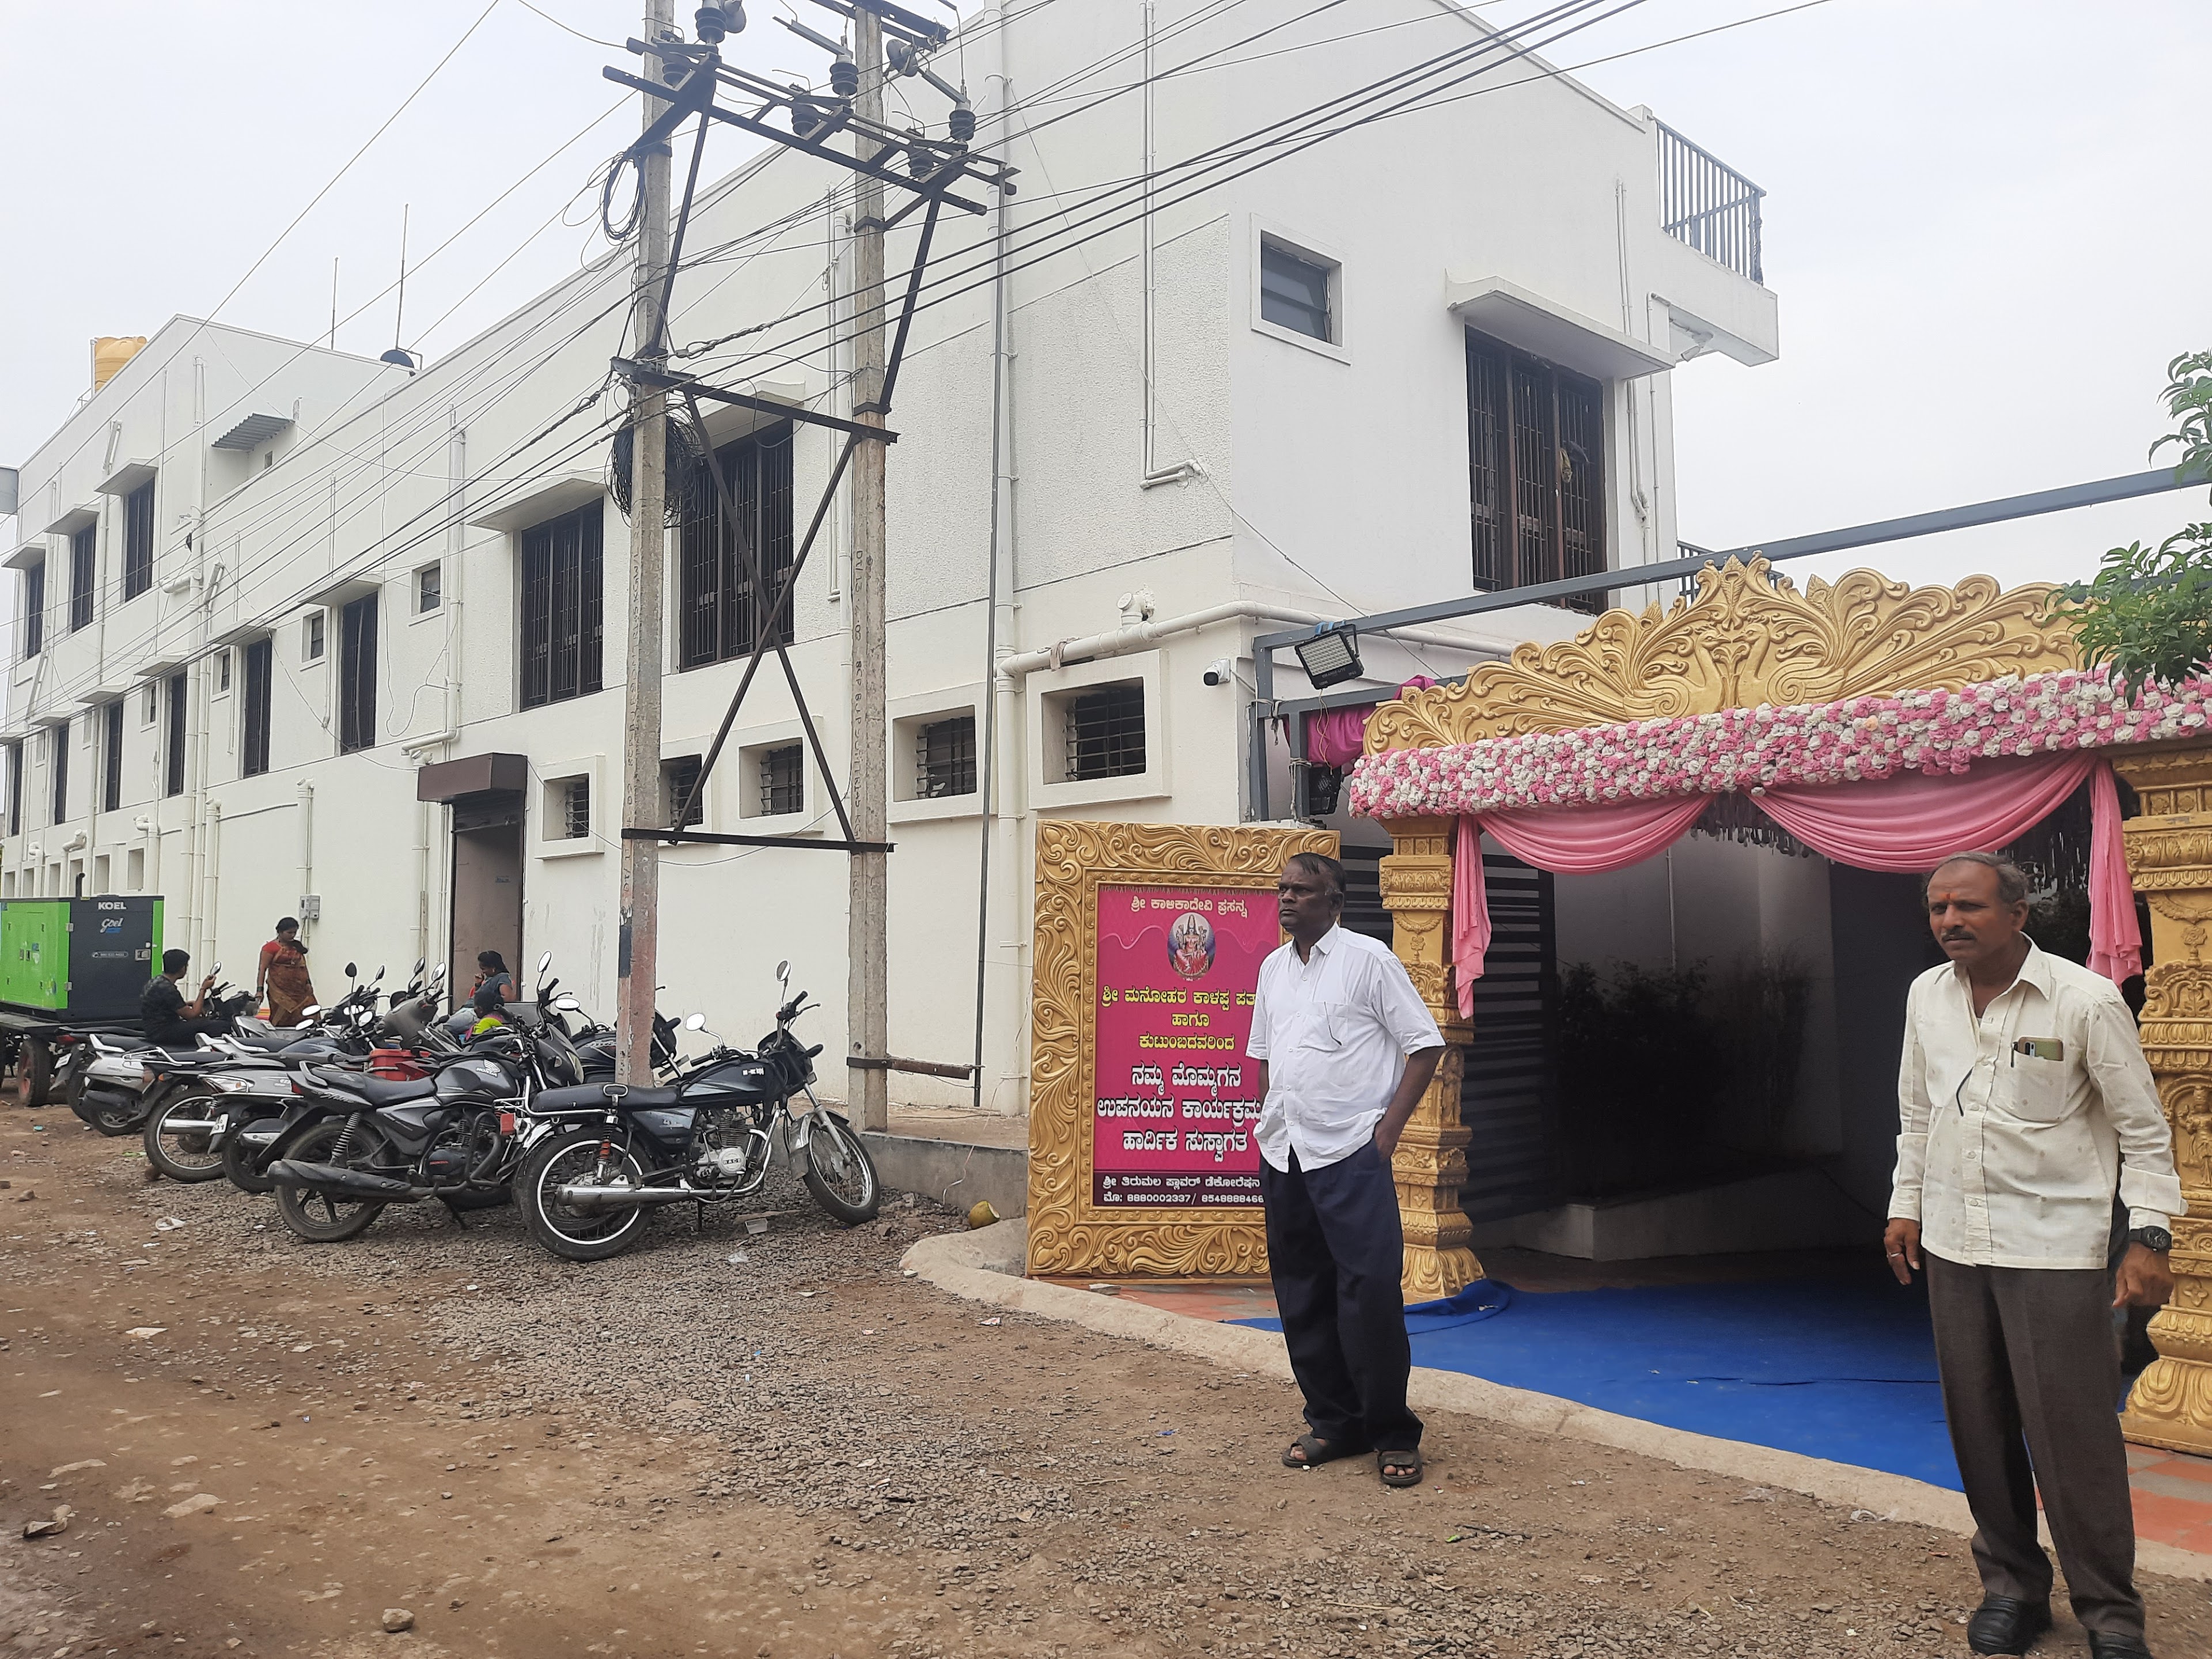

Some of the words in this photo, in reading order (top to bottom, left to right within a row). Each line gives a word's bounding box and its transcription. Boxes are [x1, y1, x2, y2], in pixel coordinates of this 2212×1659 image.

[98, 902, 127, 910] KOEL
[1131, 895, 1146, 912] ಶ್ರೀ
[1217, 898, 1248, 918] ಪ್ರಸನ್ನ
[1101, 985, 1119, 1007] ಶ್ರೀ
[1124, 986, 1187, 1004] ಮನೋಹರ
[1192, 988, 1230, 1011] ಕಾಳಪ್ಪ
[1171, 1010, 1210, 1027] ಹಾಗೂ
[1138, 1031, 1236, 1050] ಕುಟುಂಬದವರಿಂದ
[1131, 1060, 1165, 1096] ನಮ್ಮ
[1171, 1060, 1241, 1097] ಮೊಮ್ಮಗನ
[1097, 1093, 1175, 1118] ಉಪನಯನ
[1123, 1126, 1178, 1151] ಹಾರ್ದಿಕ
[1185, 1126, 1248, 1162] ಸುಸ್ವಾಗತ
[1103, 1175, 1117, 1190] ಶ್ರೀ
[1122, 1175, 1161, 1187] ತಿರುಮಲ
